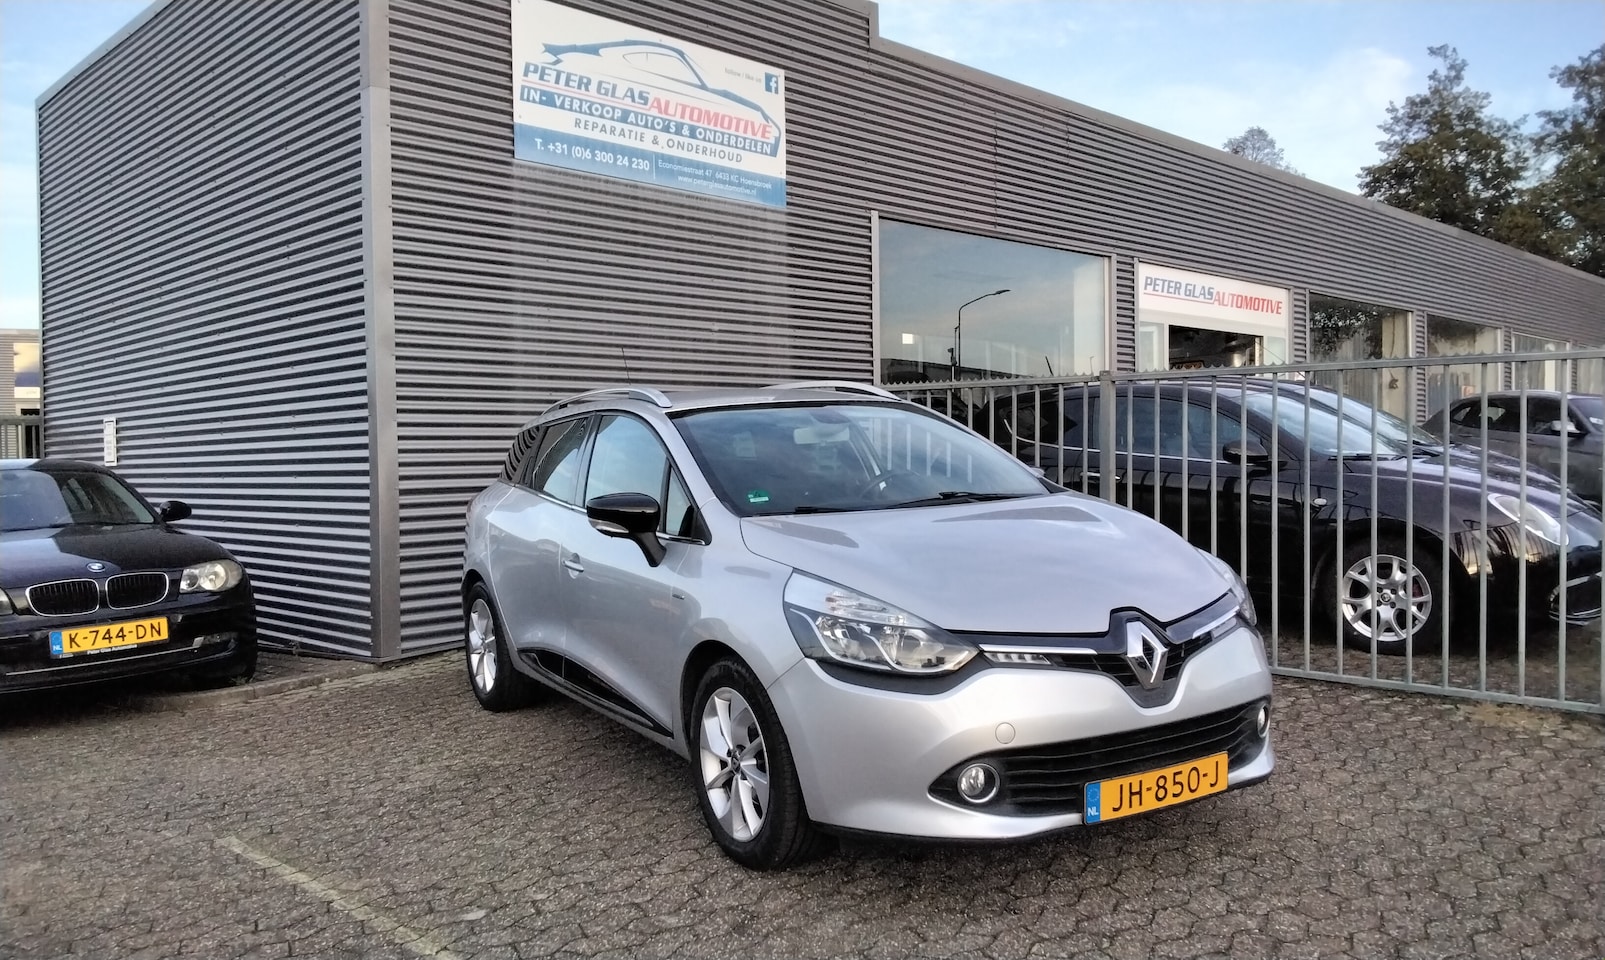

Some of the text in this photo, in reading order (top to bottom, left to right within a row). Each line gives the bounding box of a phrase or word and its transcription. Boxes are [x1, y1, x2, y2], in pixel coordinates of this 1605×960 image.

[522, 62, 592, 92] PETER
[523, 87, 771, 154] IN- VERKOOP AUTO'S & ONDERDELEN
[534, 138, 650, 171] T. +31 (0)6 300 24 230
[574, 118, 743, 163] REPARATIE & ONDERHOUD
[658, 159, 704, 176] Economiestraat
[704, 169, 713, 177] 47
[1144, 276, 1182, 296] PETER
[68, 622, 162, 649] K-744-DN
[1112, 760, 1219, 812] JH-850-J
[1087, 806, 1099, 817] NL
